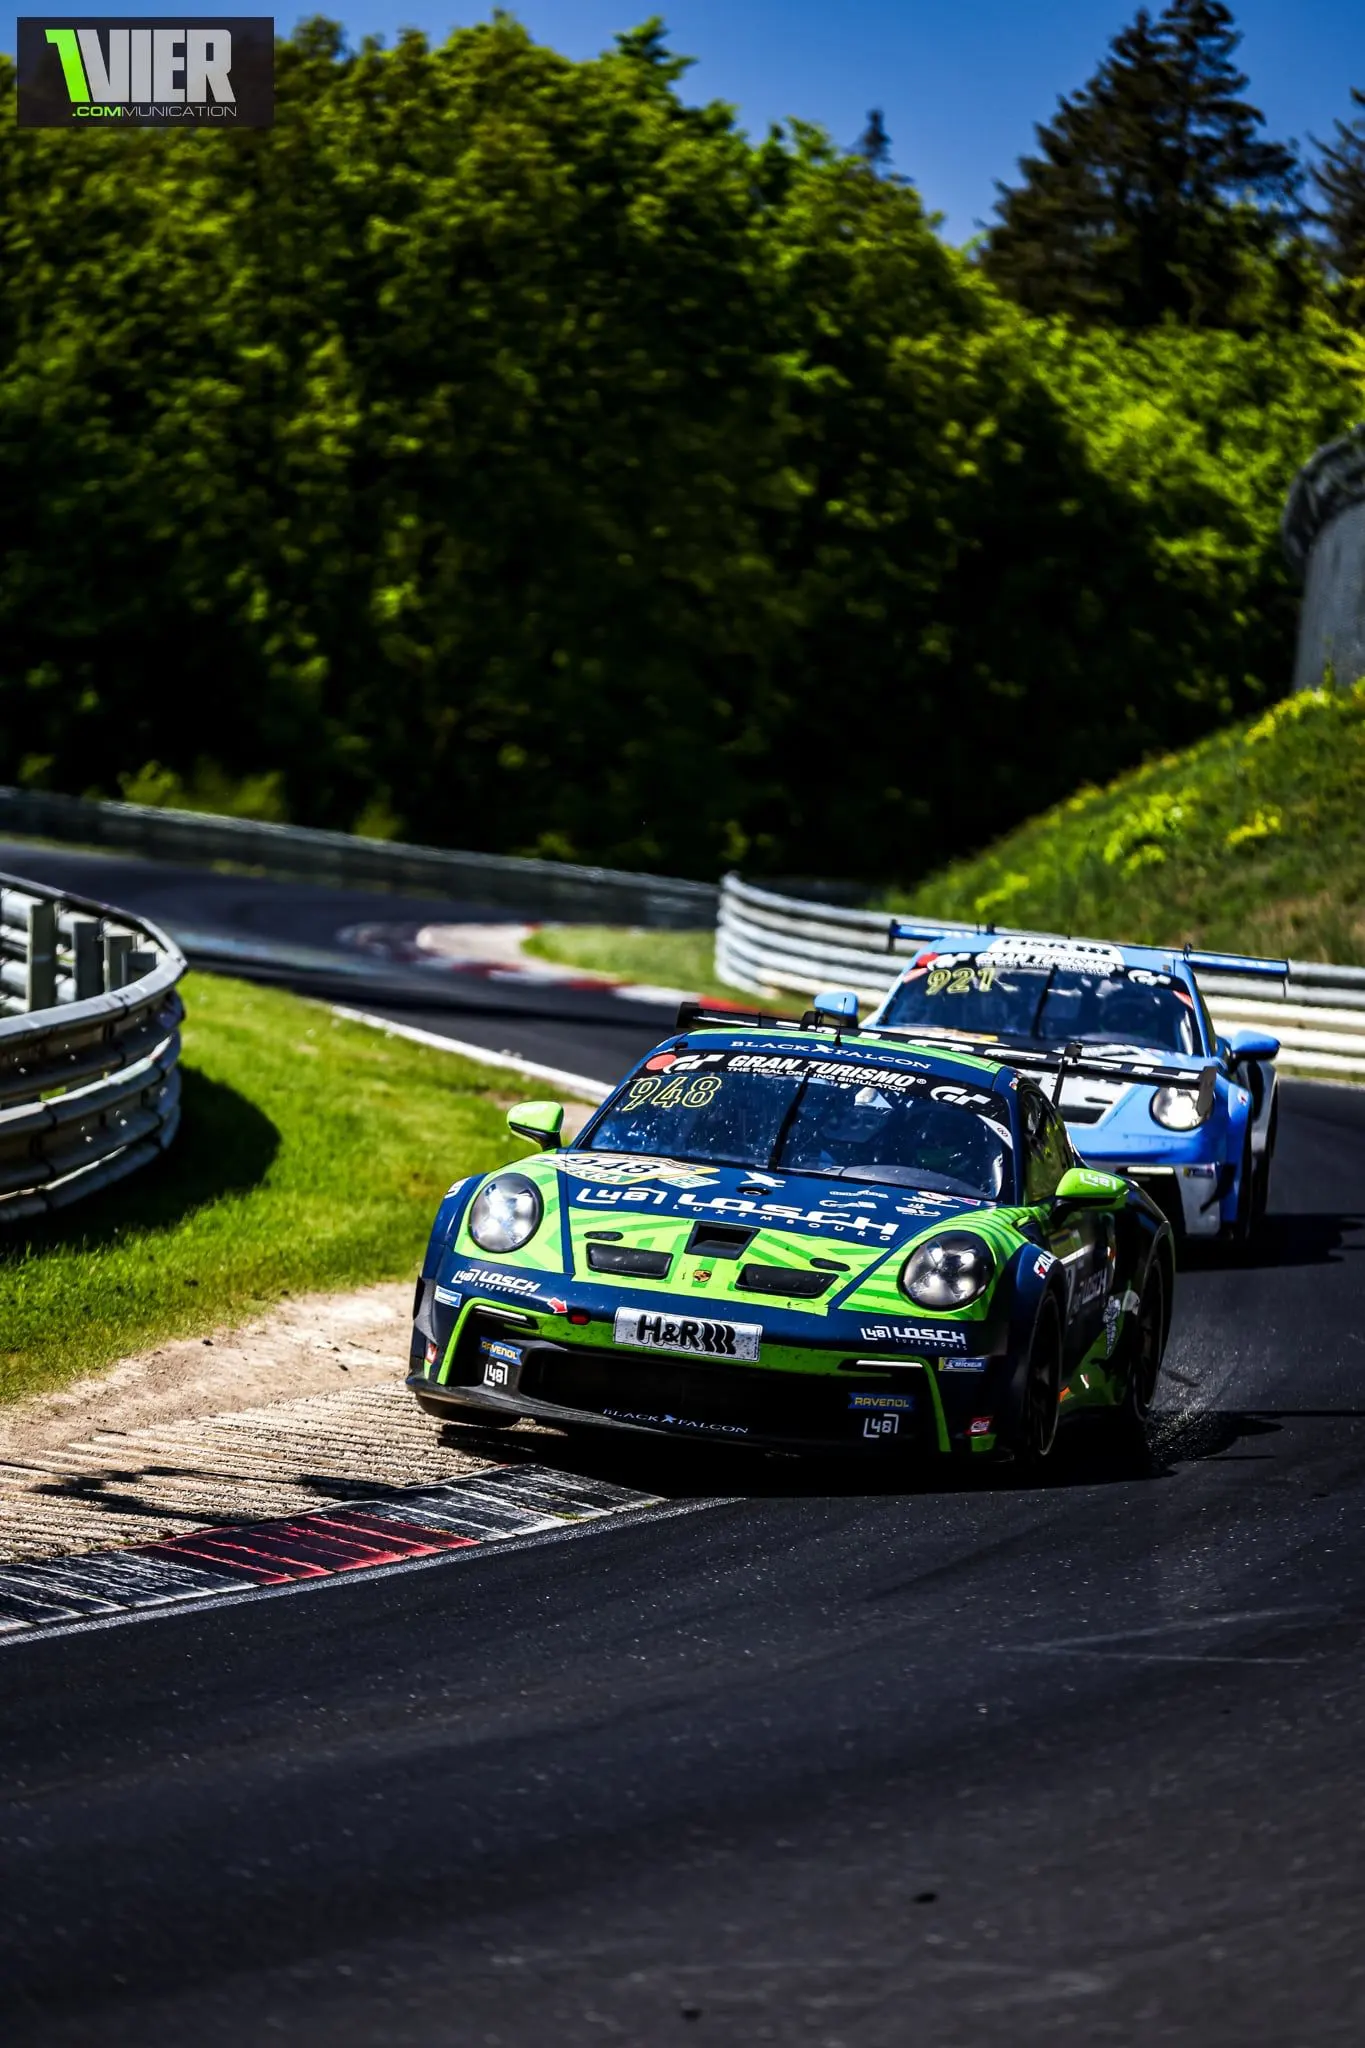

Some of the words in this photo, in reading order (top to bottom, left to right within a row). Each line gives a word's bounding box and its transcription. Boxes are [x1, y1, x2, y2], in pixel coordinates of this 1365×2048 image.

[926, 967, 995, 997] 921
[726, 1055, 802, 1073] GRAN
[730, 1040, 809, 1052] BLACK
[835, 1049, 932, 1070] FALCON
[750, 1068, 785, 1076] REAL
[787, 1070, 836, 1081] DRIING
[837, 1076, 907, 1093] SIMULATOR
[621, 1076, 722, 1112] 948
[563, 1157, 661, 1175] 948
[678, 1193, 899, 1236] LOSCH
[478, 1270, 542, 1293] LOSCH
[893, 1326, 967, 1345] LOSCH
[854, 1396, 910, 1408] RAVENOL
[602, 1408, 659, 1423] BLACK
[678, 1418, 749, 1434] FALCON
